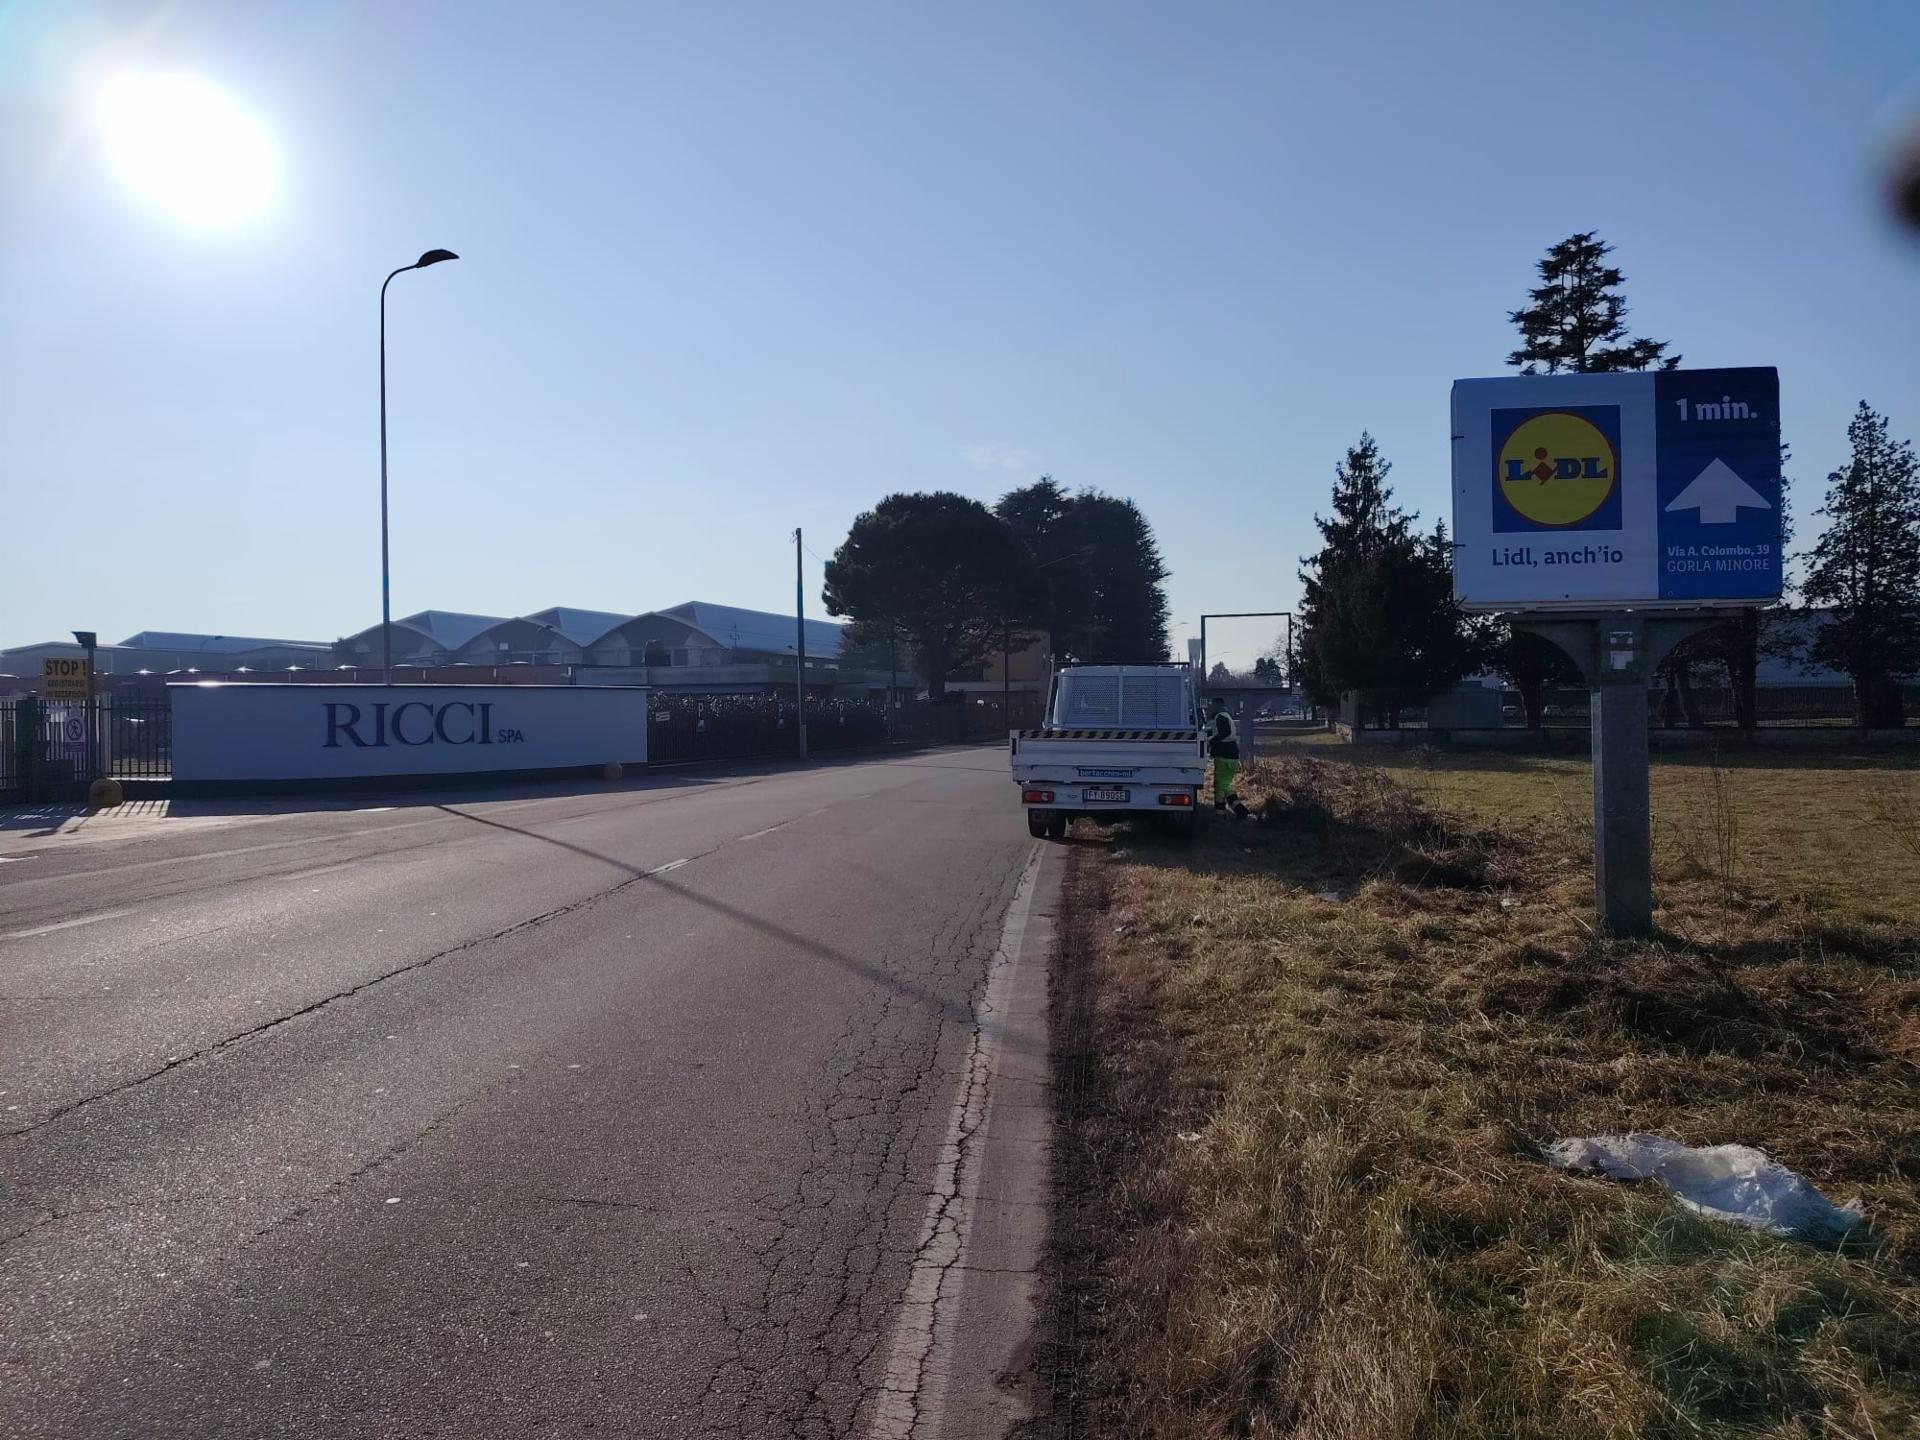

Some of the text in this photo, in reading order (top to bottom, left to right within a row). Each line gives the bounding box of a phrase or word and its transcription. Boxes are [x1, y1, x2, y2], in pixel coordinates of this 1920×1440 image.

[1675, 395, 1758, 421] 1 min.
[1492, 545, 1623, 569] Lidl, anch'io
[1667, 544, 1770, 557] Via A. Colombo, 39
[1666, 558, 1770, 572] GORLA MINORE
[321, 702, 525, 747] RICCI SPA
